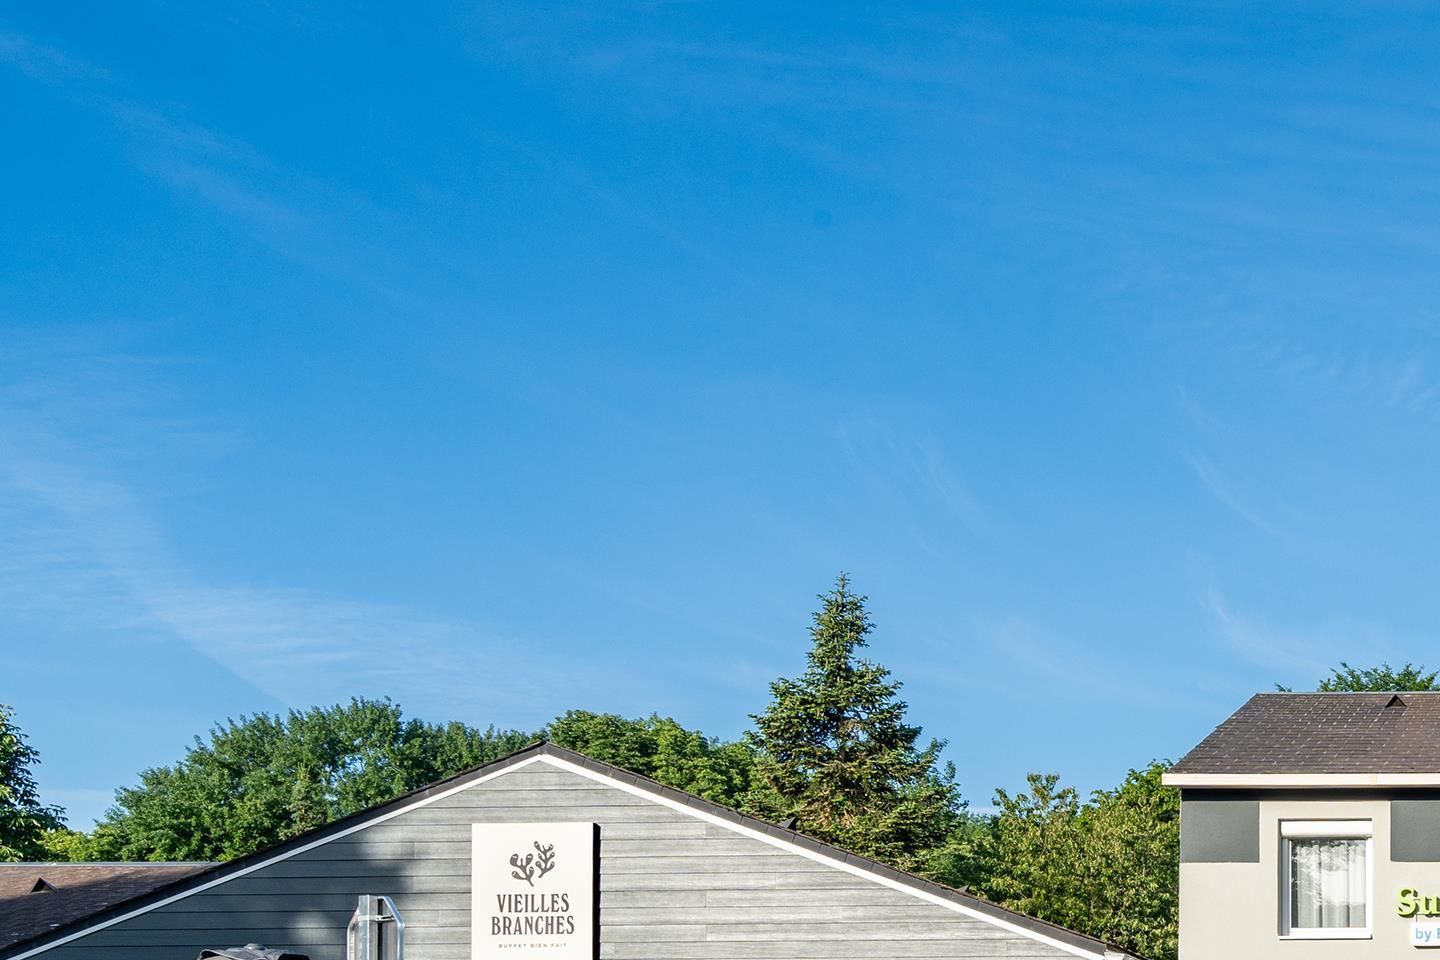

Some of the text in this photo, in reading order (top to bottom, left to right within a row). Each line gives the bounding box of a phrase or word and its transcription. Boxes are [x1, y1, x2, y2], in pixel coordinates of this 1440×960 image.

[496, 893, 570, 913] VIEILLES
[491, 915, 575, 935] BRANCHES
[1415, 928, 1432, 942] by
